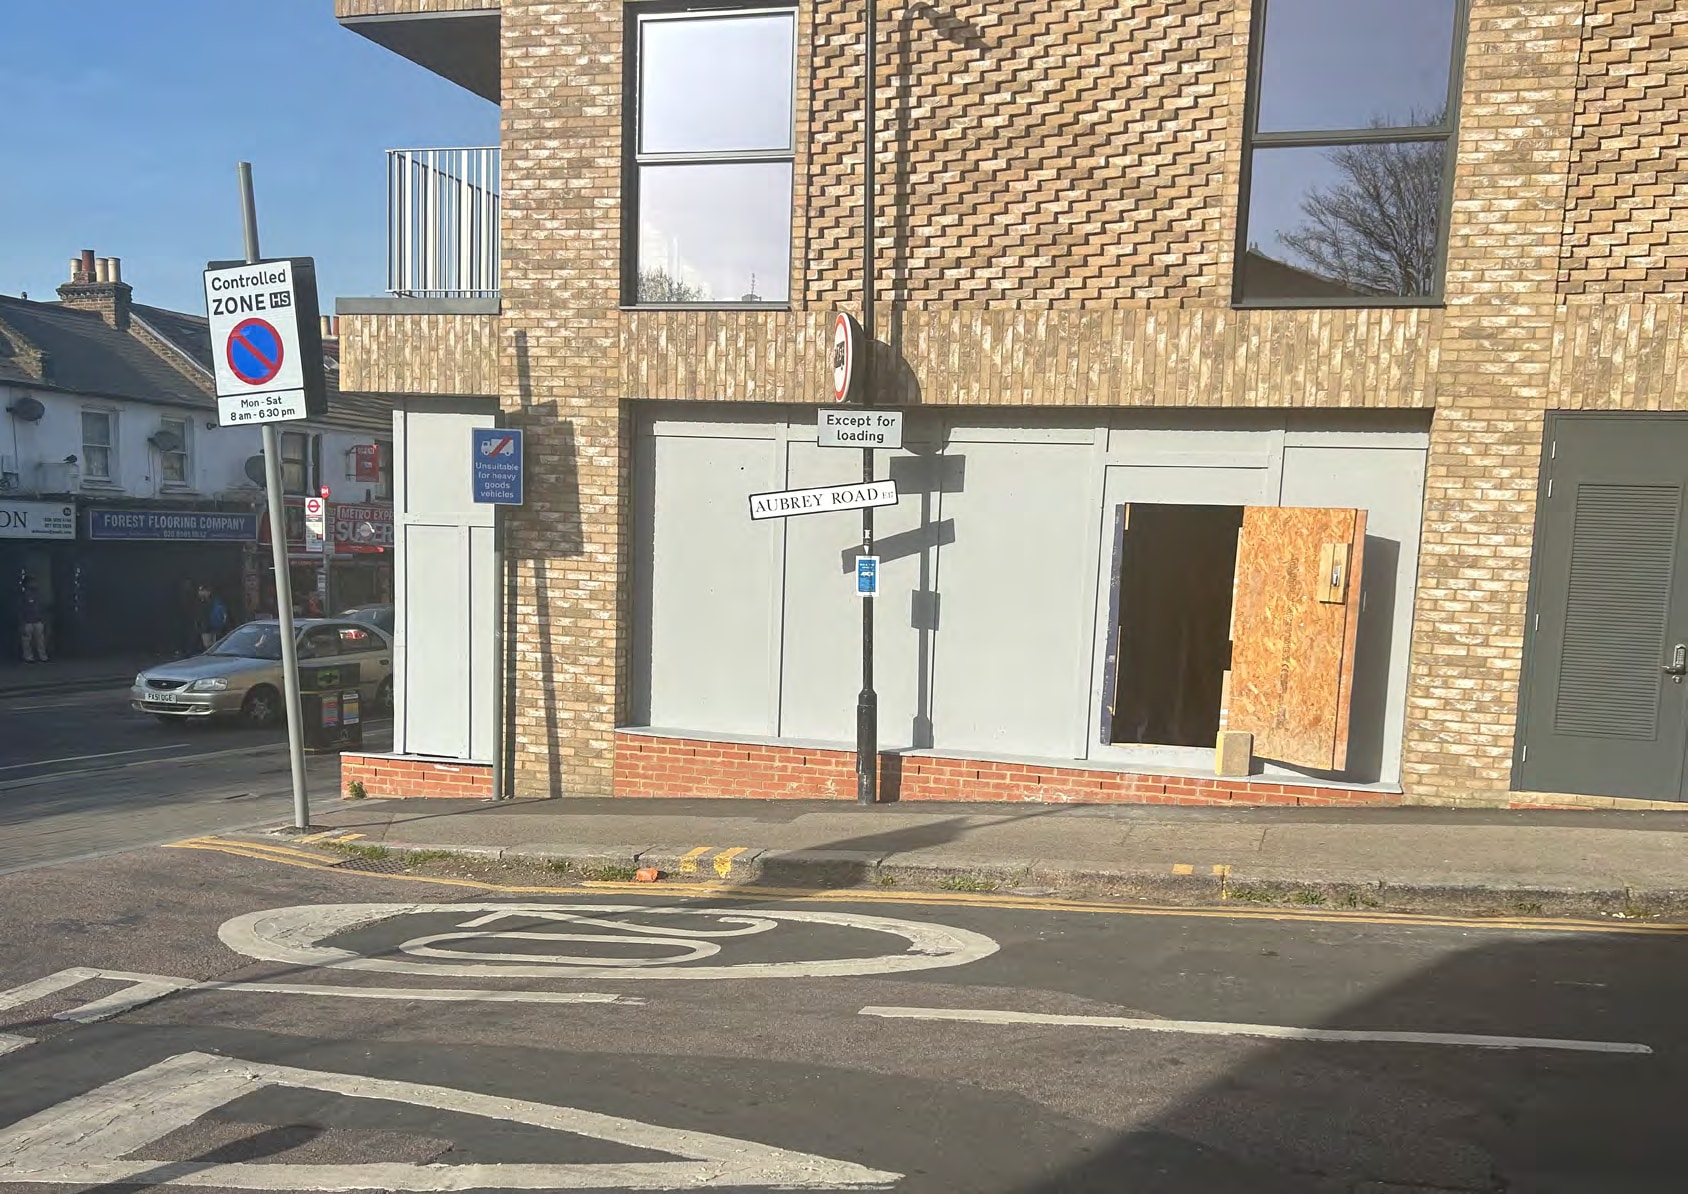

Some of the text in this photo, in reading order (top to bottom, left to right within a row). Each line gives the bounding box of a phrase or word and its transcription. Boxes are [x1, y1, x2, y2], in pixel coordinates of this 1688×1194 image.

[211, 269, 286, 290] Controlled
[212, 293, 290, 316] ZONE HS
[241, 399, 259, 408] Mon
[266, 396, 282, 405] Sat
[230, 412, 237, 421] 8
[239, 412, 252, 420] am
[281, 408, 295, 418] pm
[826, 415, 896, 427] Except for
[837, 430, 885, 443] loading
[475, 462, 519, 471] Unsuitable
[492, 472, 516, 481] heavy
[480, 490, 514, 498] vehicles
[756, 495, 824, 513] AUBREY
[832, 488, 879, 505] ROAD
[342, 508, 371, 520] METRO
[104, 514, 245, 530] FOREST FLOORING COMPANY
[335, 521, 393, 542] SUER
